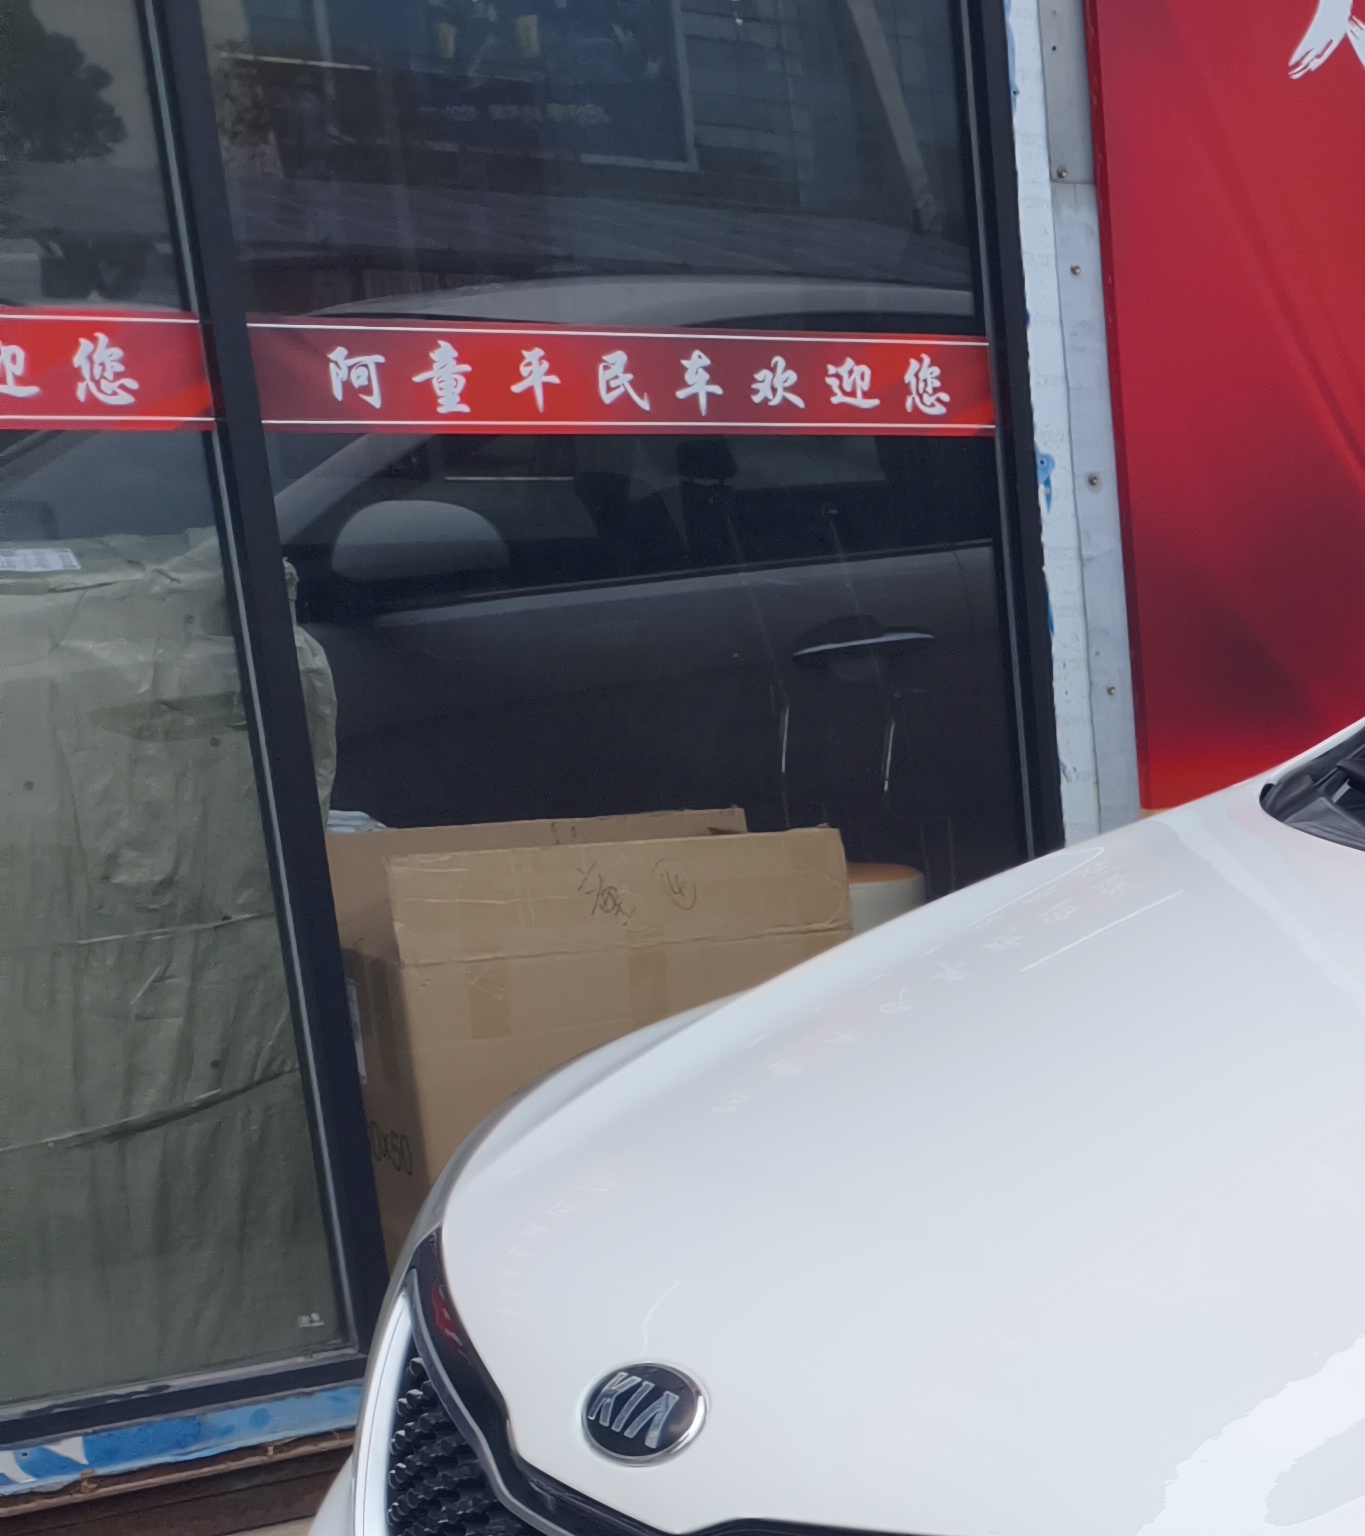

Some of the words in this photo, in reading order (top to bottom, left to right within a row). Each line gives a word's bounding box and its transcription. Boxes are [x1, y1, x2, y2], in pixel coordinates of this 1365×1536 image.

[326, 340, 951, 416] 阿童平民车欢迎您
[588, 1371, 680, 1449] KIA
